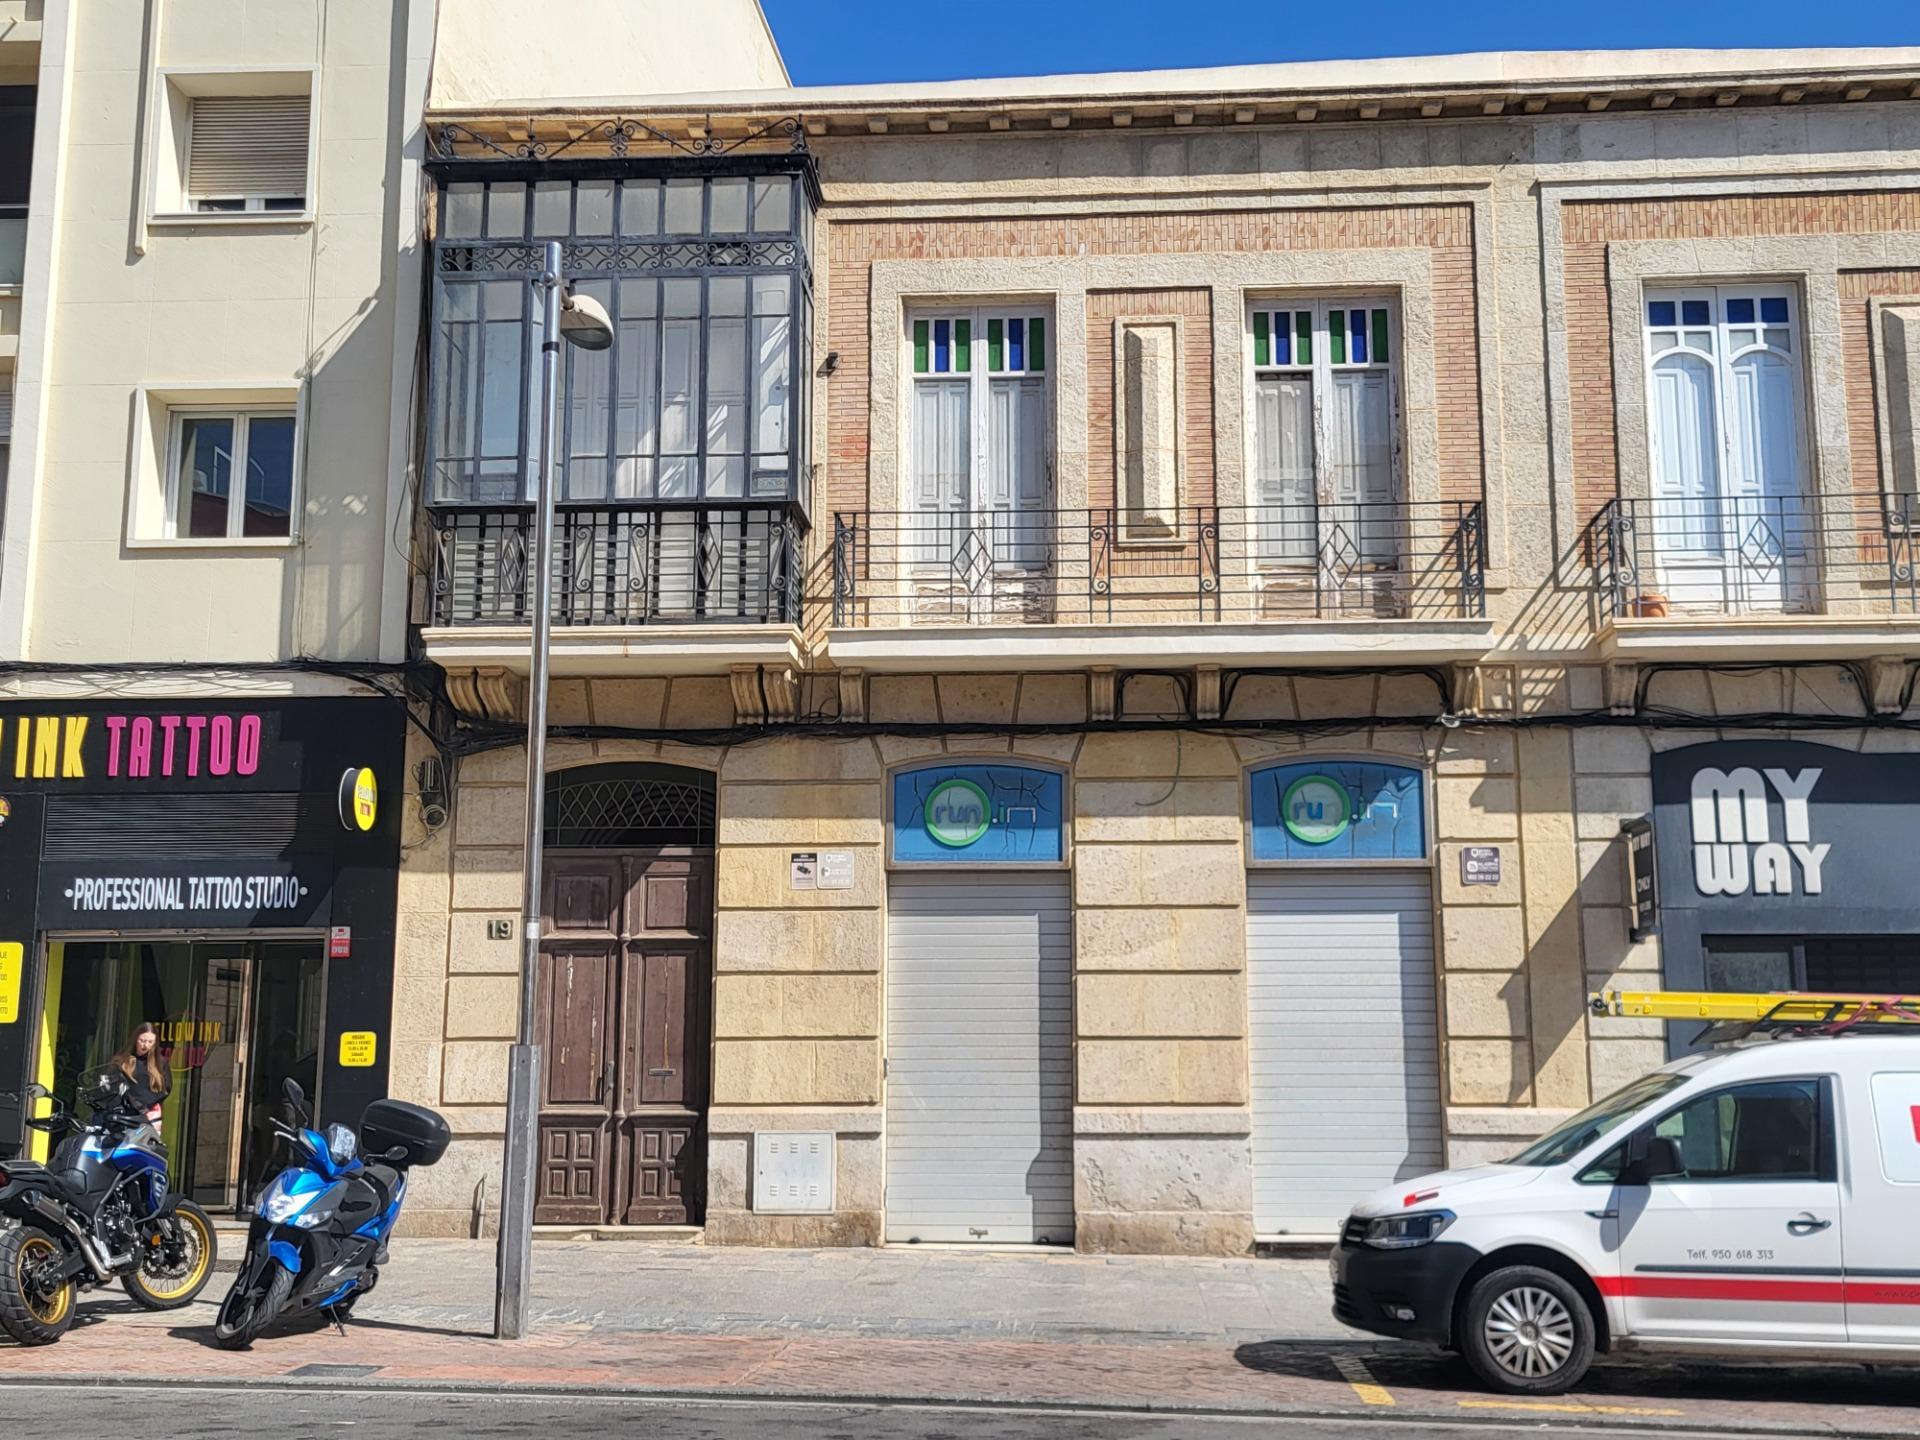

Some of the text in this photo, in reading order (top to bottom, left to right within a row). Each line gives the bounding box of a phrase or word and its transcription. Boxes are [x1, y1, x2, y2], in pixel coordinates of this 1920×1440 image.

[15, 716, 88, 778] INK
[106, 715, 261, 777] TATTOO
[1690, 767, 1823, 842] MY
[1694, 842, 1831, 895] WAY
[73, 876, 299, 911] PROFESSIONAL TATTOO STUDIO
[491, 920, 511, 938] 19
[199, 1021, 221, 1042] INK
[1712, 1248, 1732, 1260] 950
[1736, 1248, 1753, 1260] 618
[1757, 1248, 1775, 1260] 313
